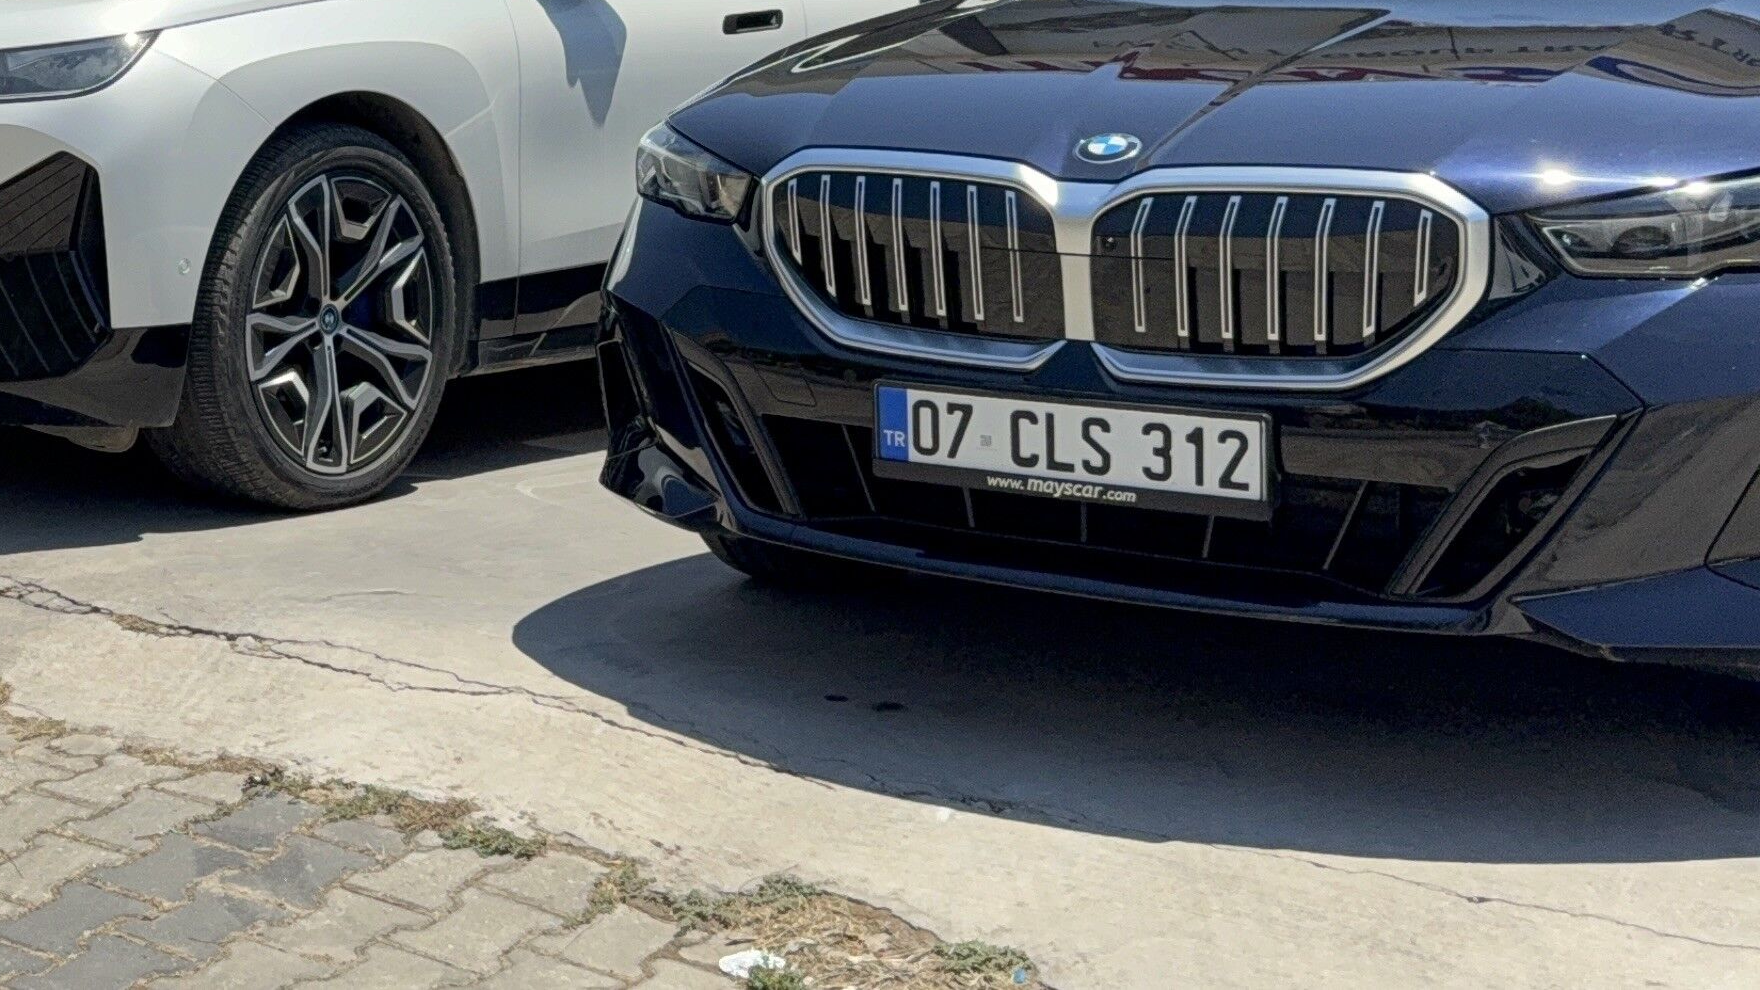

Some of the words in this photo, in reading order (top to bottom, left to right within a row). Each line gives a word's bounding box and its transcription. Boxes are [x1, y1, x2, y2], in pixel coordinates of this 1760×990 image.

[884, 428, 905, 448] TR
[911, 398, 974, 460] 07
[1009, 409, 1112, 477] CLS
[1141, 421, 1250, 492] 312
[986, 474, 1137, 503] www.mayscar.com
